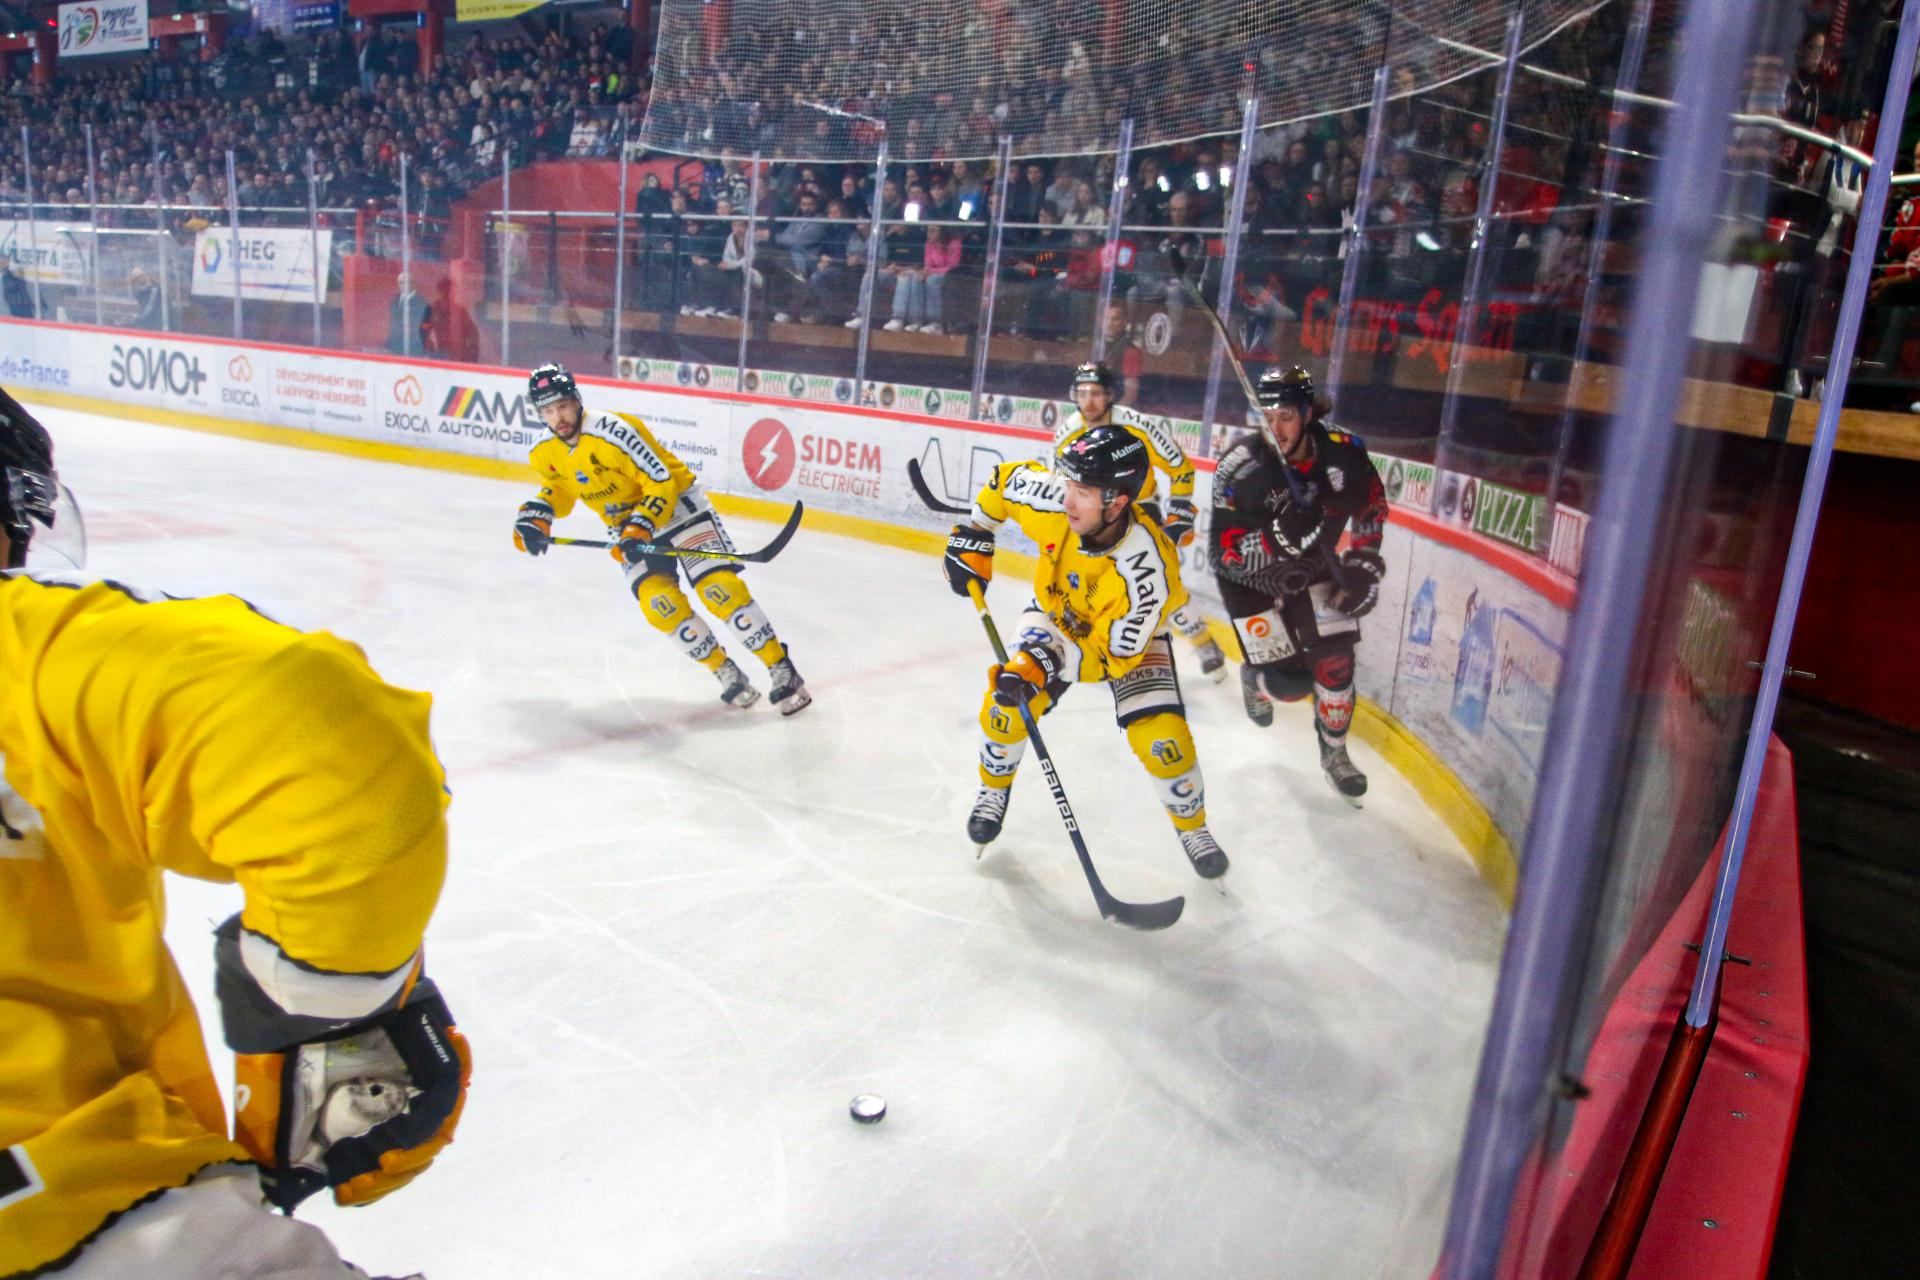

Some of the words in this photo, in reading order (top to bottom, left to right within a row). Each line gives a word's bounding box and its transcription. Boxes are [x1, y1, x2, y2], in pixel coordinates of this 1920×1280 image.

[385, 411, 430, 434] EXOCA
[1122, 409, 1180, 464] Matmut
[671, 439, 718, 456] Amiénois
[800, 434, 882, 474] SIDEM
[798, 464, 882, 499] ÉLECTRICITÉ
[1477, 483, 1539, 551] PIZZA
